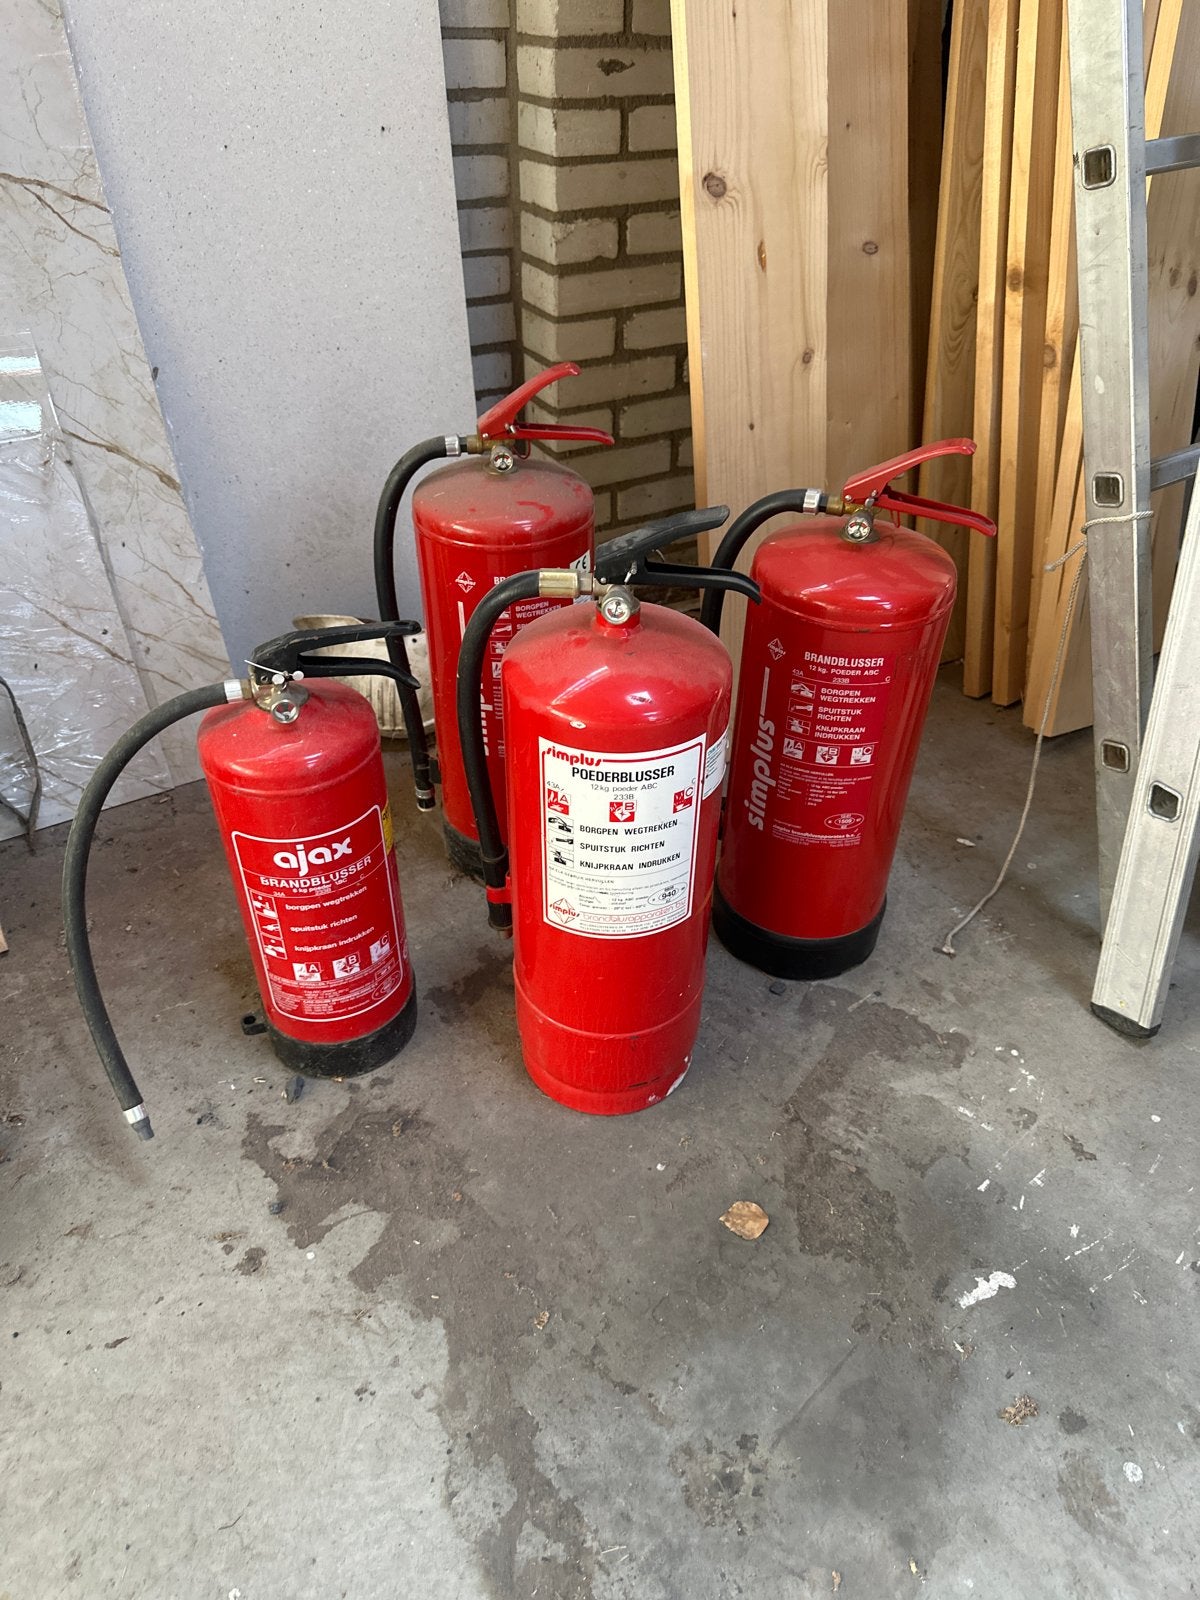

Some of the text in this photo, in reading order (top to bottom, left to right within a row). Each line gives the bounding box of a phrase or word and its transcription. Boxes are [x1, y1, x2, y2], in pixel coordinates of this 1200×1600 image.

[515, 601, 549, 612] BORGPEN
[804, 651, 884, 668] BRANDBLUSSER
[809, 664, 817, 672] 12
[820, 687, 861, 697] BORGPEN
[820, 694, 876, 704] WEGTREKKEN
[818, 706, 863, 715] SPUITSTUK
[817, 713, 852, 722] RICHTEN
[815, 724, 866, 734] KNIJPKRAAN
[814, 731, 861, 740] INDRUKKEN
[545, 746, 602, 767] simplus
[572, 765, 675, 783] POEDERBLUSSER
[744, 714, 777, 831] simplus
[599, 784, 610, 792] kg
[612, 785, 638, 793] poeder
[641, 782, 658, 790] ABC
[684, 786, 694, 797] C
[613, 793, 635, 801] 233B
[624, 802, 635, 811] B
[579, 819, 678, 836] BORGPEN WEGTREKKEN
[580, 840, 666, 853] SPUITSTUK RICHTEN
[273, 836, 353, 877] ajax
[579, 852, 681, 871] KNIJPKRAAN INDRUKKEN
[260, 856, 372, 889] BRANDBLUSSER
[285, 885, 367, 912] borgpen wegtrekken
[661, 889, 677, 900] 940
[290, 914, 358, 932] spuitstuk richten
[294, 926, 375, 953] knijpkraan indrukken
